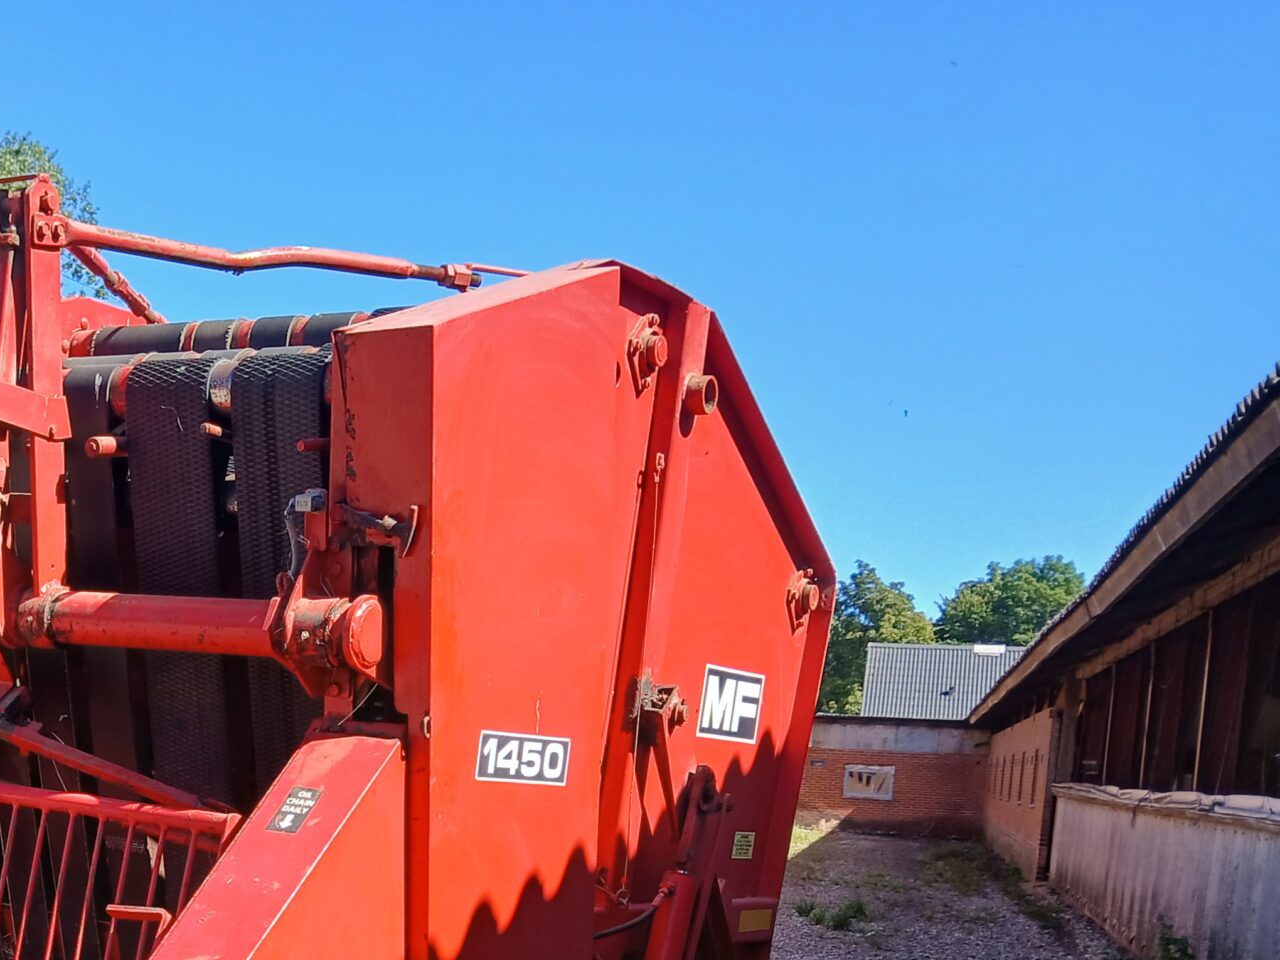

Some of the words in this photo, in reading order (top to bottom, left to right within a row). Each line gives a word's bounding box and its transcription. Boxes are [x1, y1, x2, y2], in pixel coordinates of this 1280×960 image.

[701, 674, 762, 733] MF
[483, 738, 564, 778] 1450
[281, 804, 310, 814] DAILY
[286, 797, 316, 807] CHAIN
